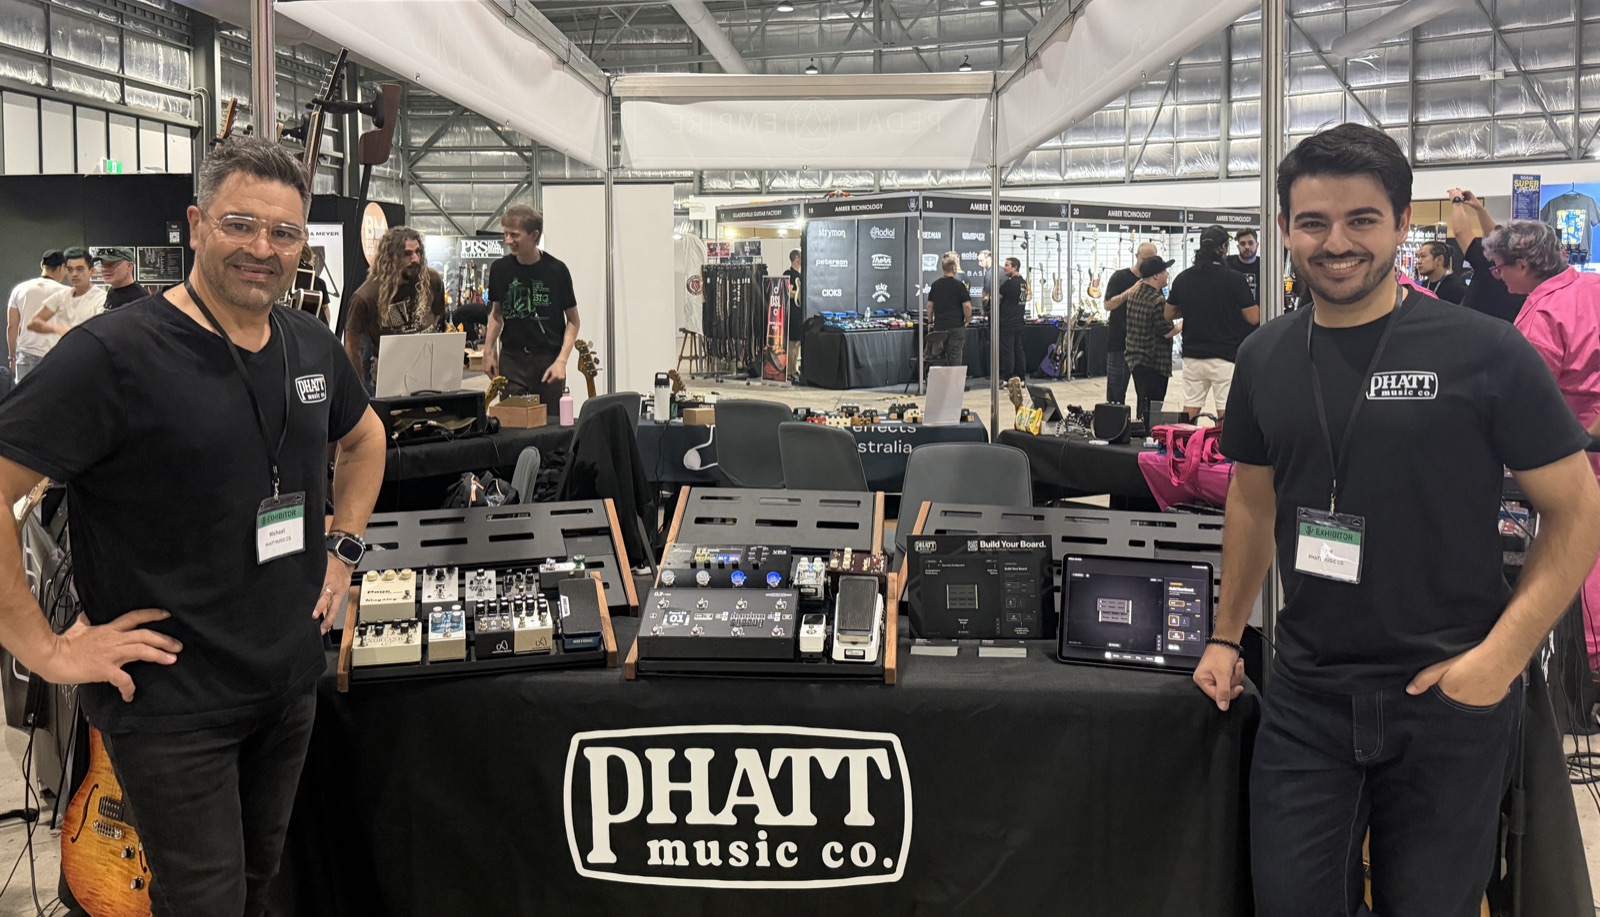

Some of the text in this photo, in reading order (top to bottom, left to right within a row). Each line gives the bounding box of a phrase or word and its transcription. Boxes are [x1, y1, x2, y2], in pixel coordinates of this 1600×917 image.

[851, 203, 883, 212] TECHNOLOGY
[926, 200, 933, 209] 18
[970, 203, 1026, 213] AMBER THNOLOGY
[766, 209, 782, 217] FACTORY
[1123, 211, 1151, 219] TECHNOLOGY
[1229, 215, 1251, 223] TECHNOLOGY
[818, 228, 846, 238] strymon
[875, 227, 895, 237] Radial
[461, 240, 488, 253] PRS
[815, 259, 848, 267] peterson
[821, 289, 842, 297] CIOKS
[298, 378, 325, 400] PHATT
[1369, 374, 1434, 397] PHATT
[1381, 388, 1414, 397] music
[857, 440, 912, 454] stralia
[267, 509, 297, 523] EXHIBITOR
[269, 528, 286, 537] Michael
[1315, 528, 1353, 541] EXHIBITOR
[980, 540, 1047, 548] Build Your Board.
[669, 615, 684, 623] 01
[583, 746, 892, 864] PHATT
[647, 829, 894, 869] music co.
